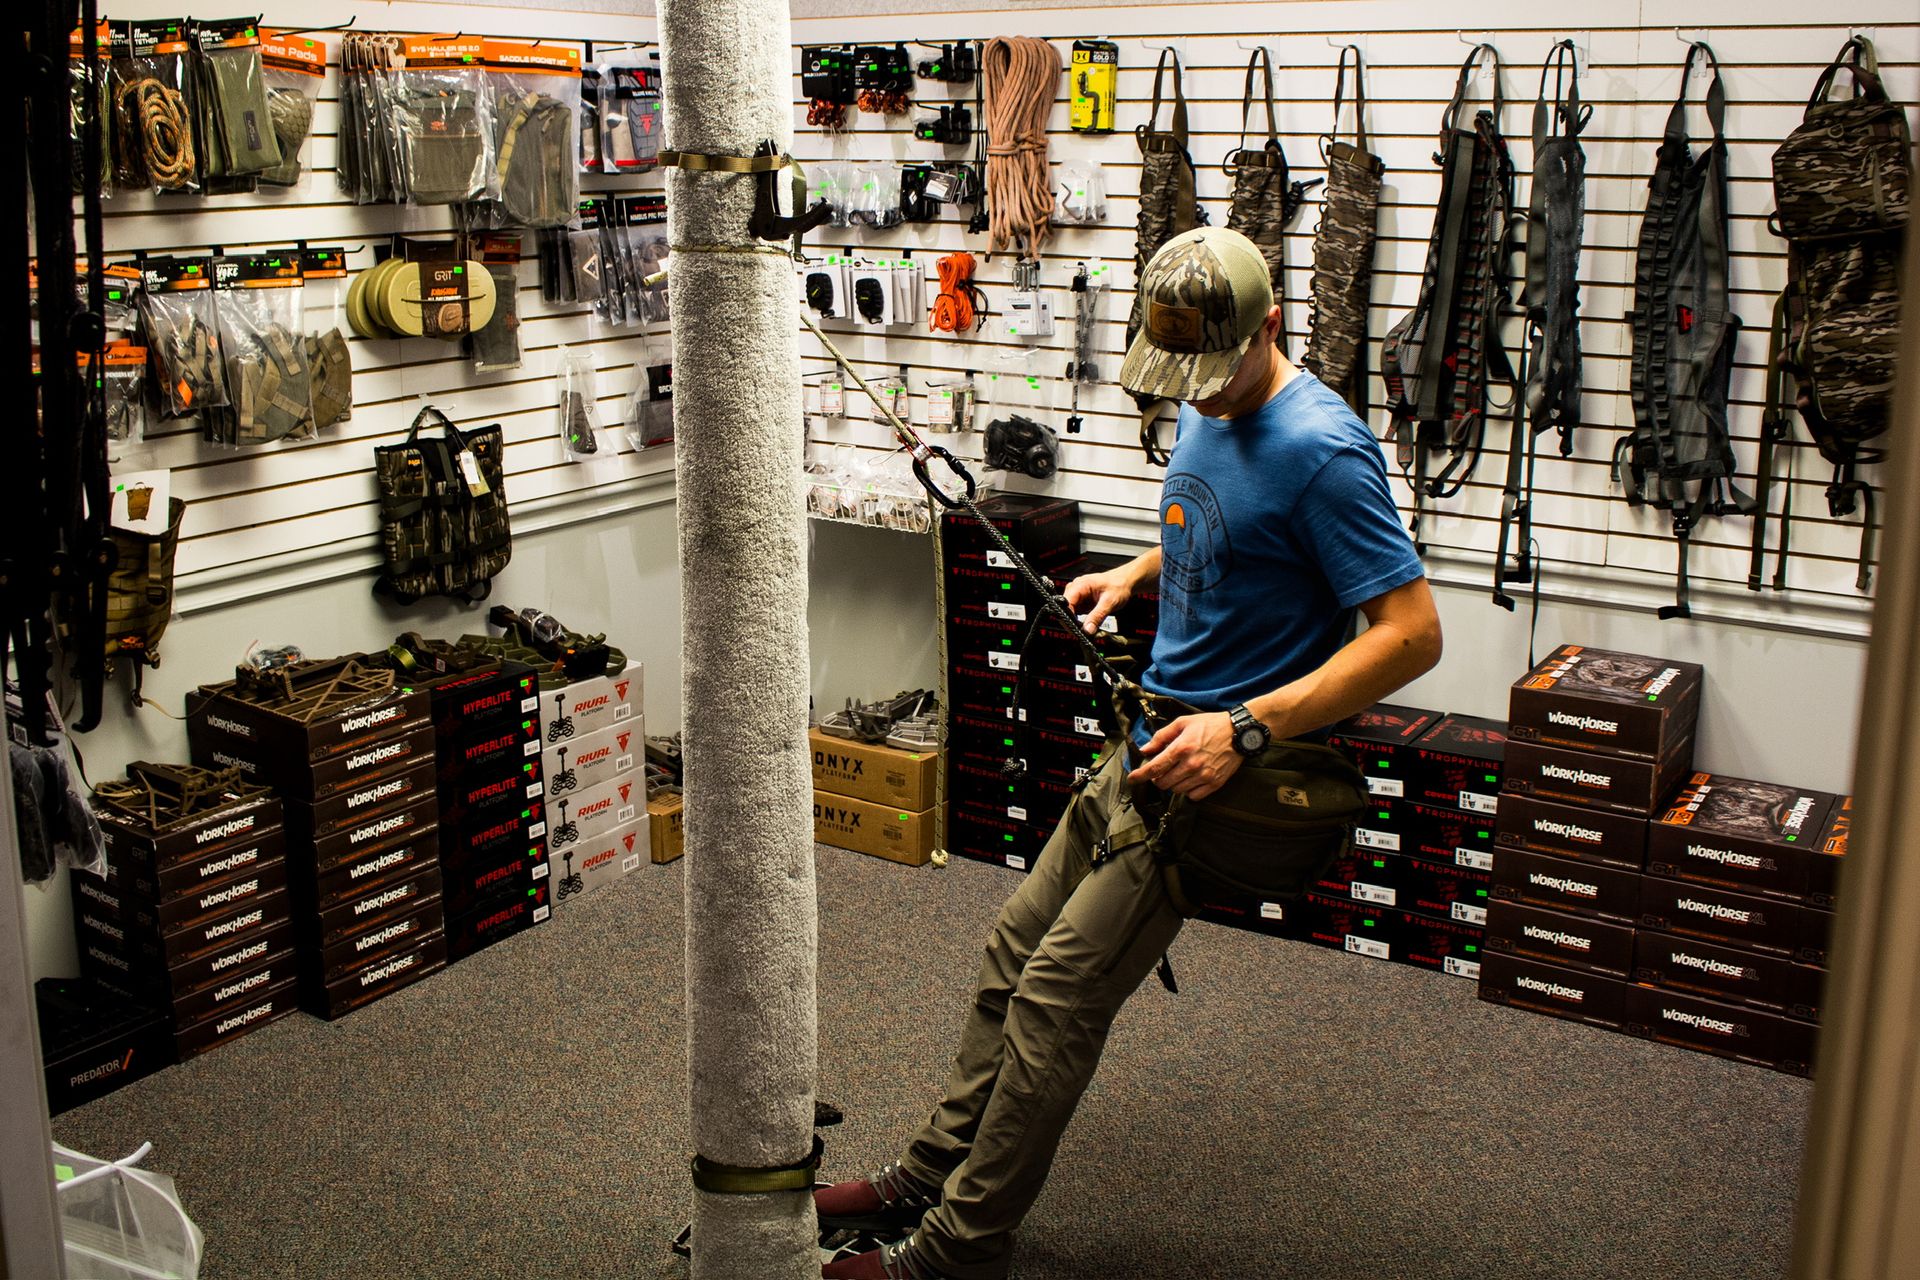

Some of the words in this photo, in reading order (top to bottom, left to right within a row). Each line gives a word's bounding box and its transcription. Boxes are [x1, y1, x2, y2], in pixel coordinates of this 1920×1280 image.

[134, 37, 158, 45] TETHER
[261, 44, 286, 56] nee
[288, 46, 318, 62] Pads
[216, 266, 239, 277] YOKE
[1188, 481, 1219, 531] MOUNTAIN
[957, 517, 1014, 528] TROPLINE
[960, 568, 1017, 581] TROPHYLINE
[962, 618, 1018, 633] TROPHYLINE
[463, 690, 513, 716] HYPERLITE
[574, 695, 610, 713] RIVAL
[581, 706, 604, 718] PLATFORM
[207, 714, 252, 736] WORKHORSE
[341, 706, 397, 733] WORKHORSE
[1548, 711, 1619, 733] WORKHORSE
[346, 743, 401, 771] WORKHORSE
[465, 733, 515, 759] HYPERLITE
[576, 746, 612, 766] RIVAL
[212, 751, 257, 774] WORKHORSE
[583, 757, 606, 769] PLATFORM
[815, 751, 864, 776] ONYX
[1429, 753, 1500, 771] TROPHYLINE
[822, 767, 857, 782] PLATFORM
[1541, 764, 1611, 787] WORKHORSE
[347, 779, 402, 809] WORKHORSE
[467, 778, 517, 804] HYPERLITE
[1424, 789, 1458, 801] COVERT
[578, 798, 613, 818] RIVAL
[584, 809, 607, 822] PLATFORM
[814, 803, 861, 828] ONYX
[1425, 806, 1495, 827] TROPHYLINE
[195, 815, 255, 844] WORKHORSE
[350, 814, 405, 844] WORKHORSE
[471, 818, 520, 847] HYPERLITE
[819, 820, 854, 834] PLATFORM
[1534, 818, 1603, 842] WORKHORSE
[199, 848, 258, 877] WORKHORSE
[350, 848, 405, 879] WORKHORSE
[582, 848, 617, 870] RIVAL
[589, 859, 612, 873] PLATFORM
[1687, 844, 1761, 868] WORKHORSE
[475, 860, 523, 889] HYPERLITE
[1421, 863, 1491, 883] TROPHYLINE
[1529, 872, 1599, 896] WORKHORSE
[199, 879, 258, 909] WORKHORSE
[354, 884, 408, 915] WORKHORSE
[476, 903, 524, 932] HYPERLITE
[1316, 897, 1384, 918] TROPHYLINE
[1677, 898, 1750, 922] WORKHORSE
[205, 909, 263, 940] WORKHORSE
[355, 921, 410, 951] WORKHORSE
[1414, 917, 1484, 937] TROPHYLINE
[1311, 931, 1345, 944] COVERT
[1523, 925, 1591, 949] WORKHORSE
[211, 941, 268, 972] WORKHORSE
[1408, 953, 1443, 965] COVERT
[1671, 952, 1744, 977] WORKHORSE
[360, 955, 414, 986] WORKHORSE
[214, 970, 271, 1002] WORKHORSE
[1516, 976, 1585, 1000] WORKHORSE
[216, 1002, 273, 1035] WORKHORSE
[1662, 1008, 1734, 1034] WORKHORSE
[69, 1058, 121, 1088] PREDATOR
